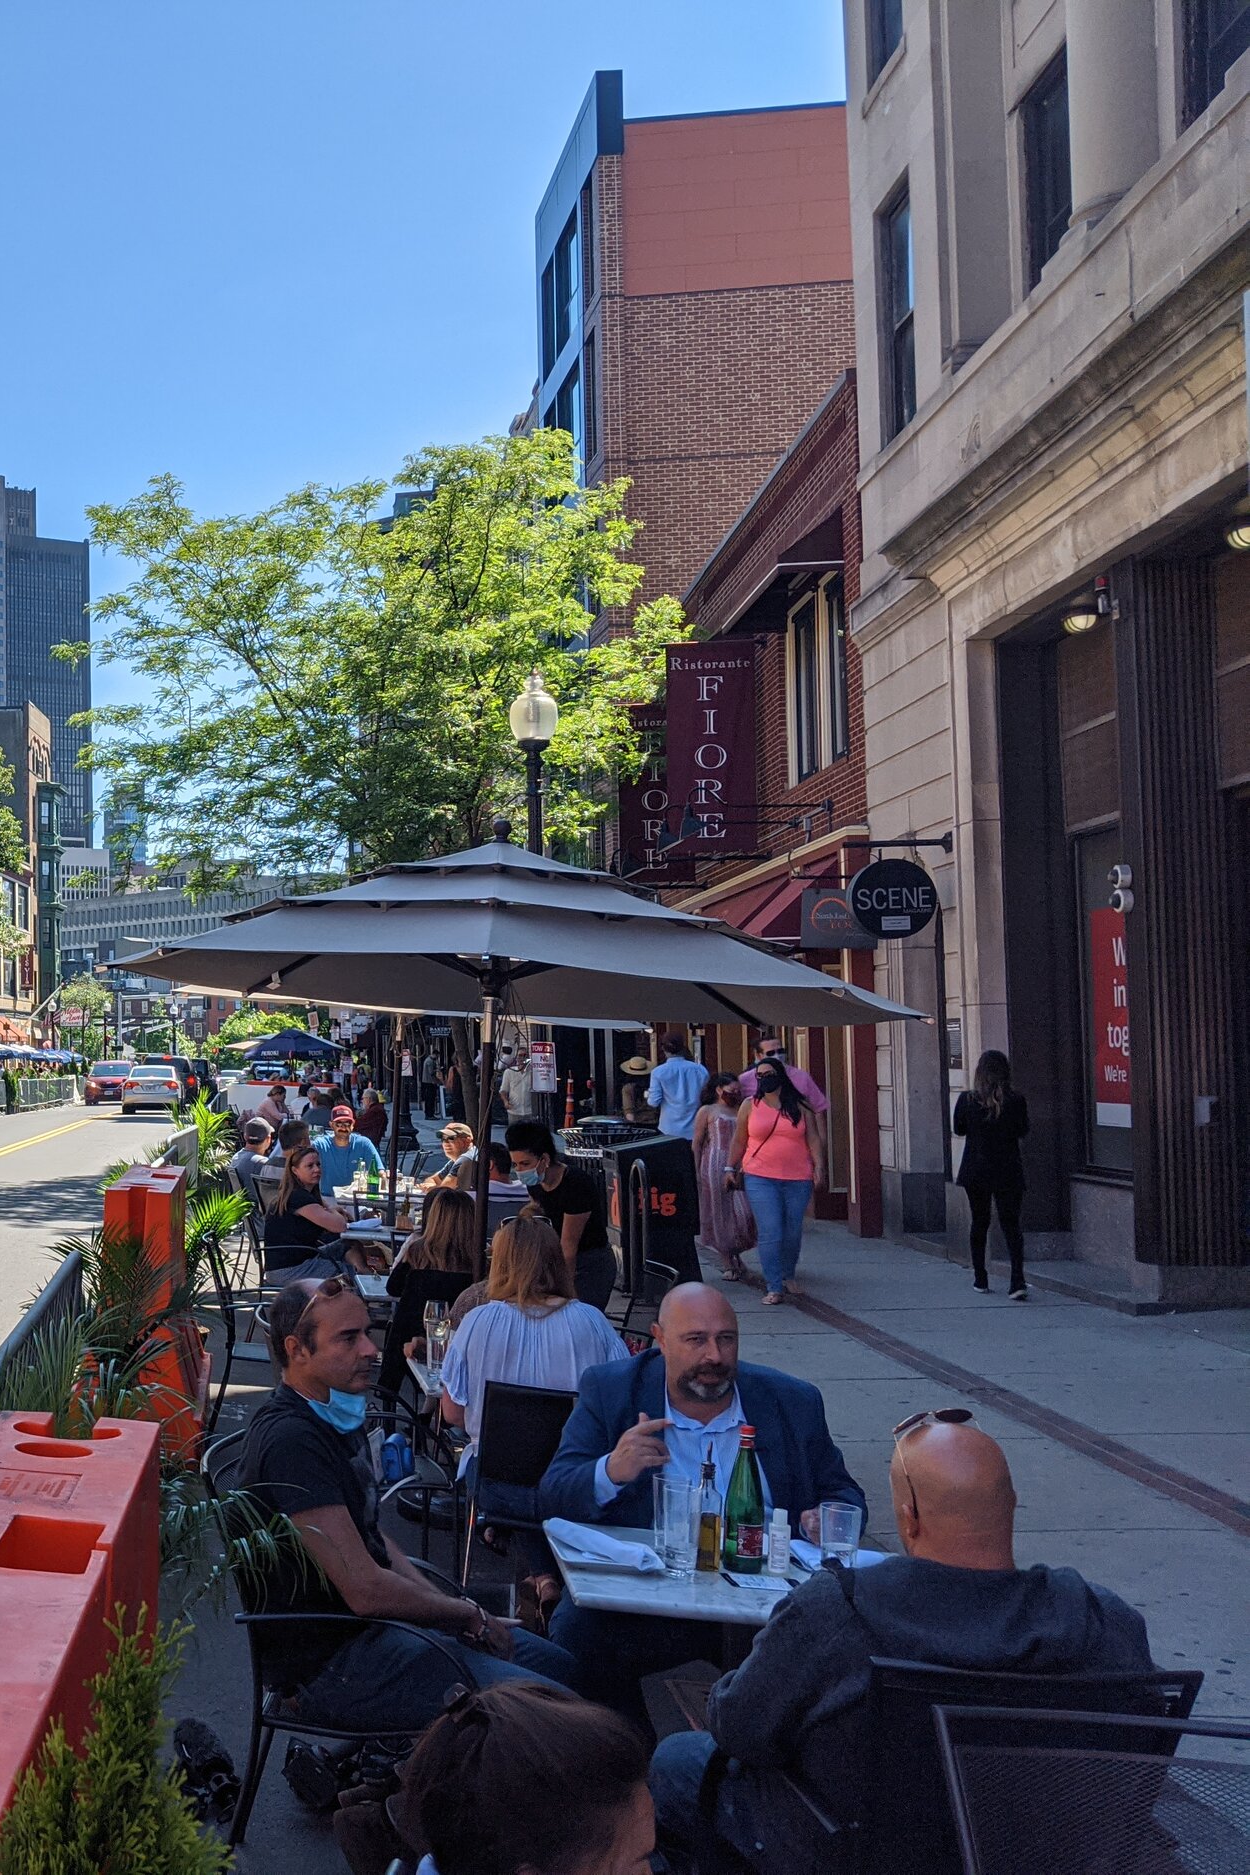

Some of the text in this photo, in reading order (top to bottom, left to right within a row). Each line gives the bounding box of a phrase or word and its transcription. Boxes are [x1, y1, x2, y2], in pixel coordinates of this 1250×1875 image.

[671, 657, 750, 670] Ristorante
[634, 719, 667, 727] istora
[694, 675, 728, 838] FIORE
[857, 886, 932, 910] SCENE
[1113, 978, 1127, 1007] in
[532, 1044, 544, 1052] TOW
[1104, 1065, 1127, 1083] We're
[575, 1149, 599, 1158] Recycle
